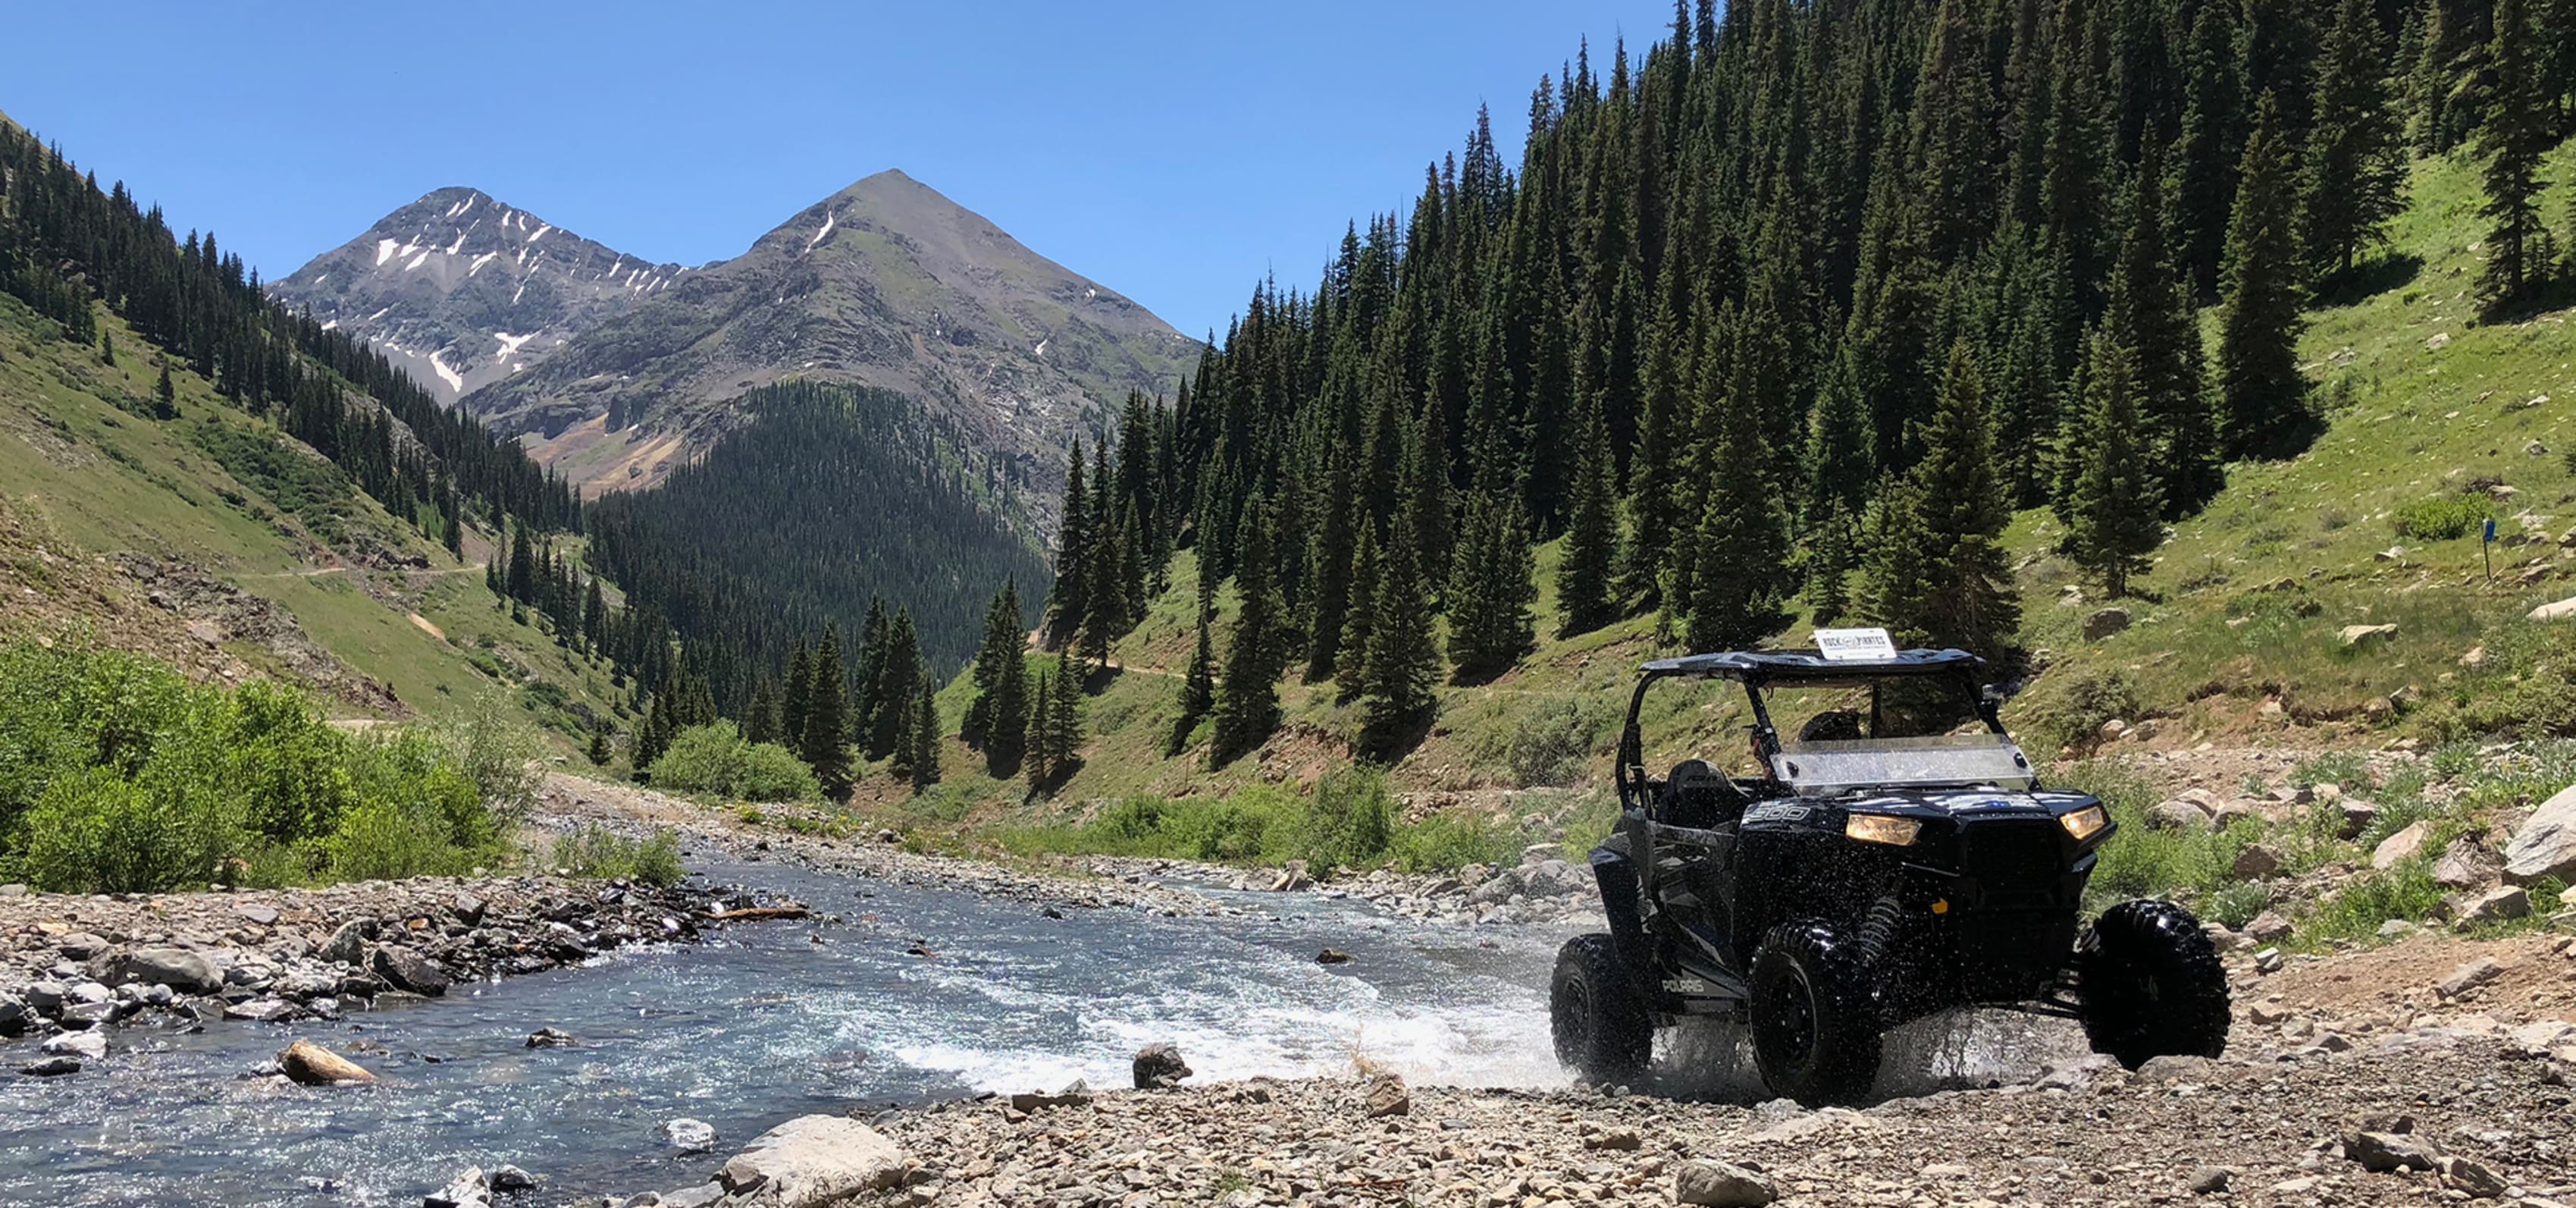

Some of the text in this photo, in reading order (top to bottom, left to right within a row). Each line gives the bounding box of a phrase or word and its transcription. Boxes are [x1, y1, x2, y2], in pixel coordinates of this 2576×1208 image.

[1822, 635, 1886, 647] ROCK PIRATES
[1662, 980, 1704, 992] POLARIS
